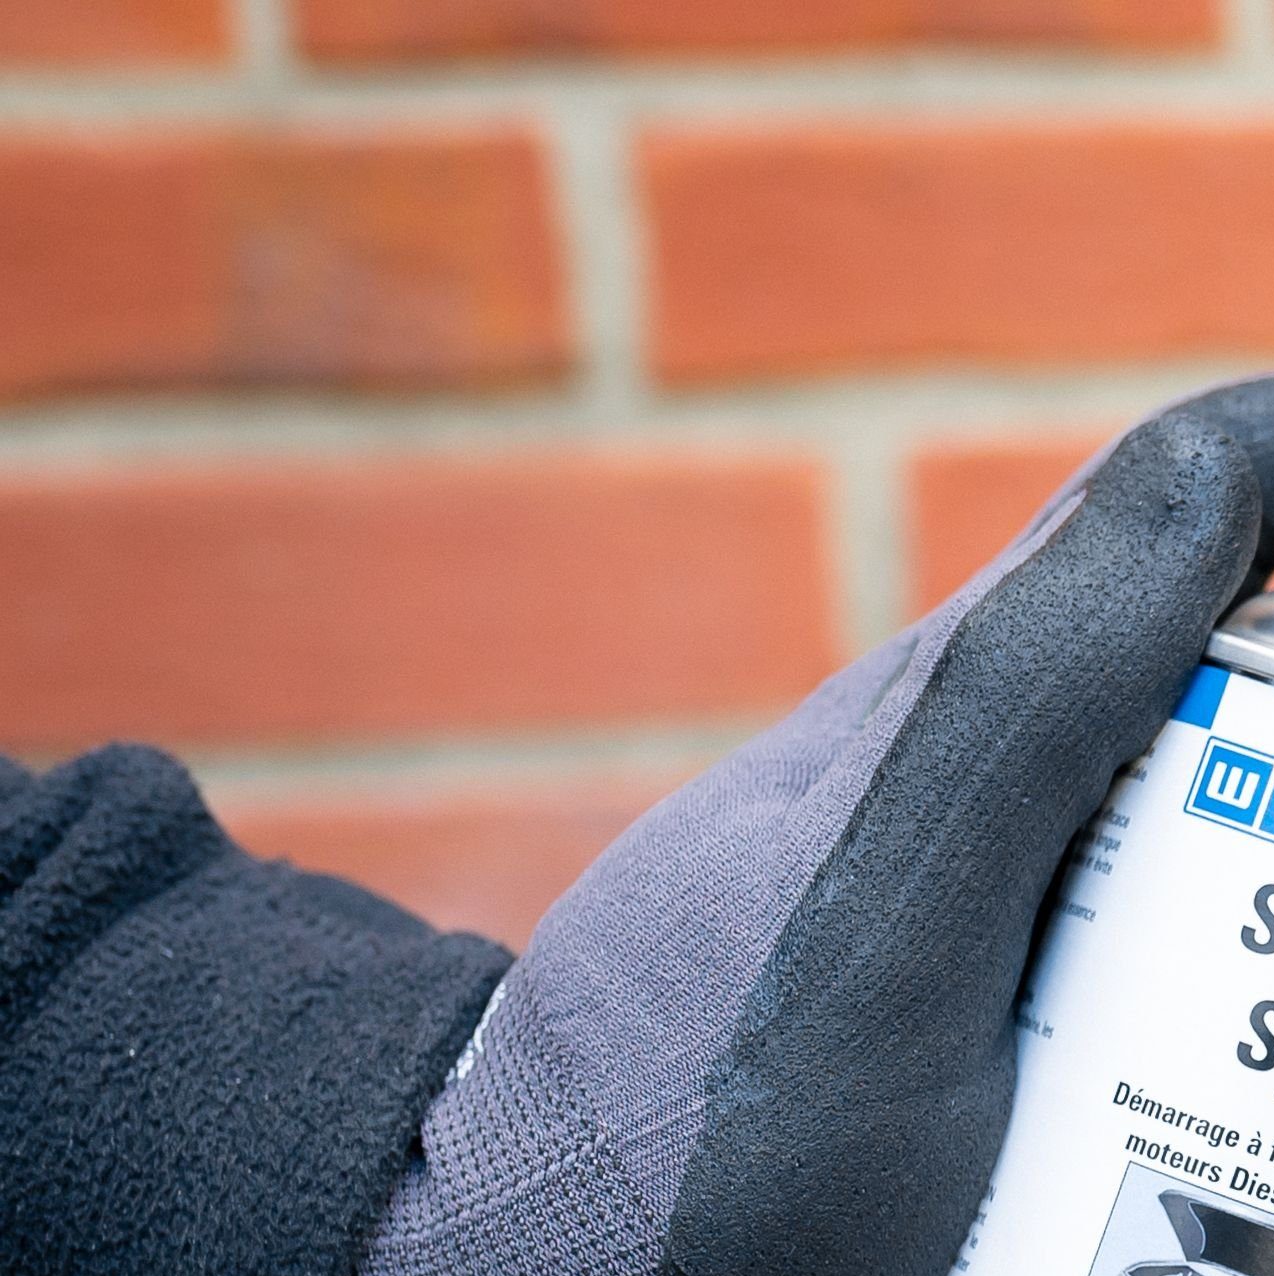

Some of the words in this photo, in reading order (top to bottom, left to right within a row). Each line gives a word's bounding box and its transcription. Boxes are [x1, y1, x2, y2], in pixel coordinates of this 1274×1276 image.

[1112, 1080, 1240, 1149] Démarrage
[1246, 1130, 1261, 1156] à
[1124, 1131, 1222, 1184] moteurs
